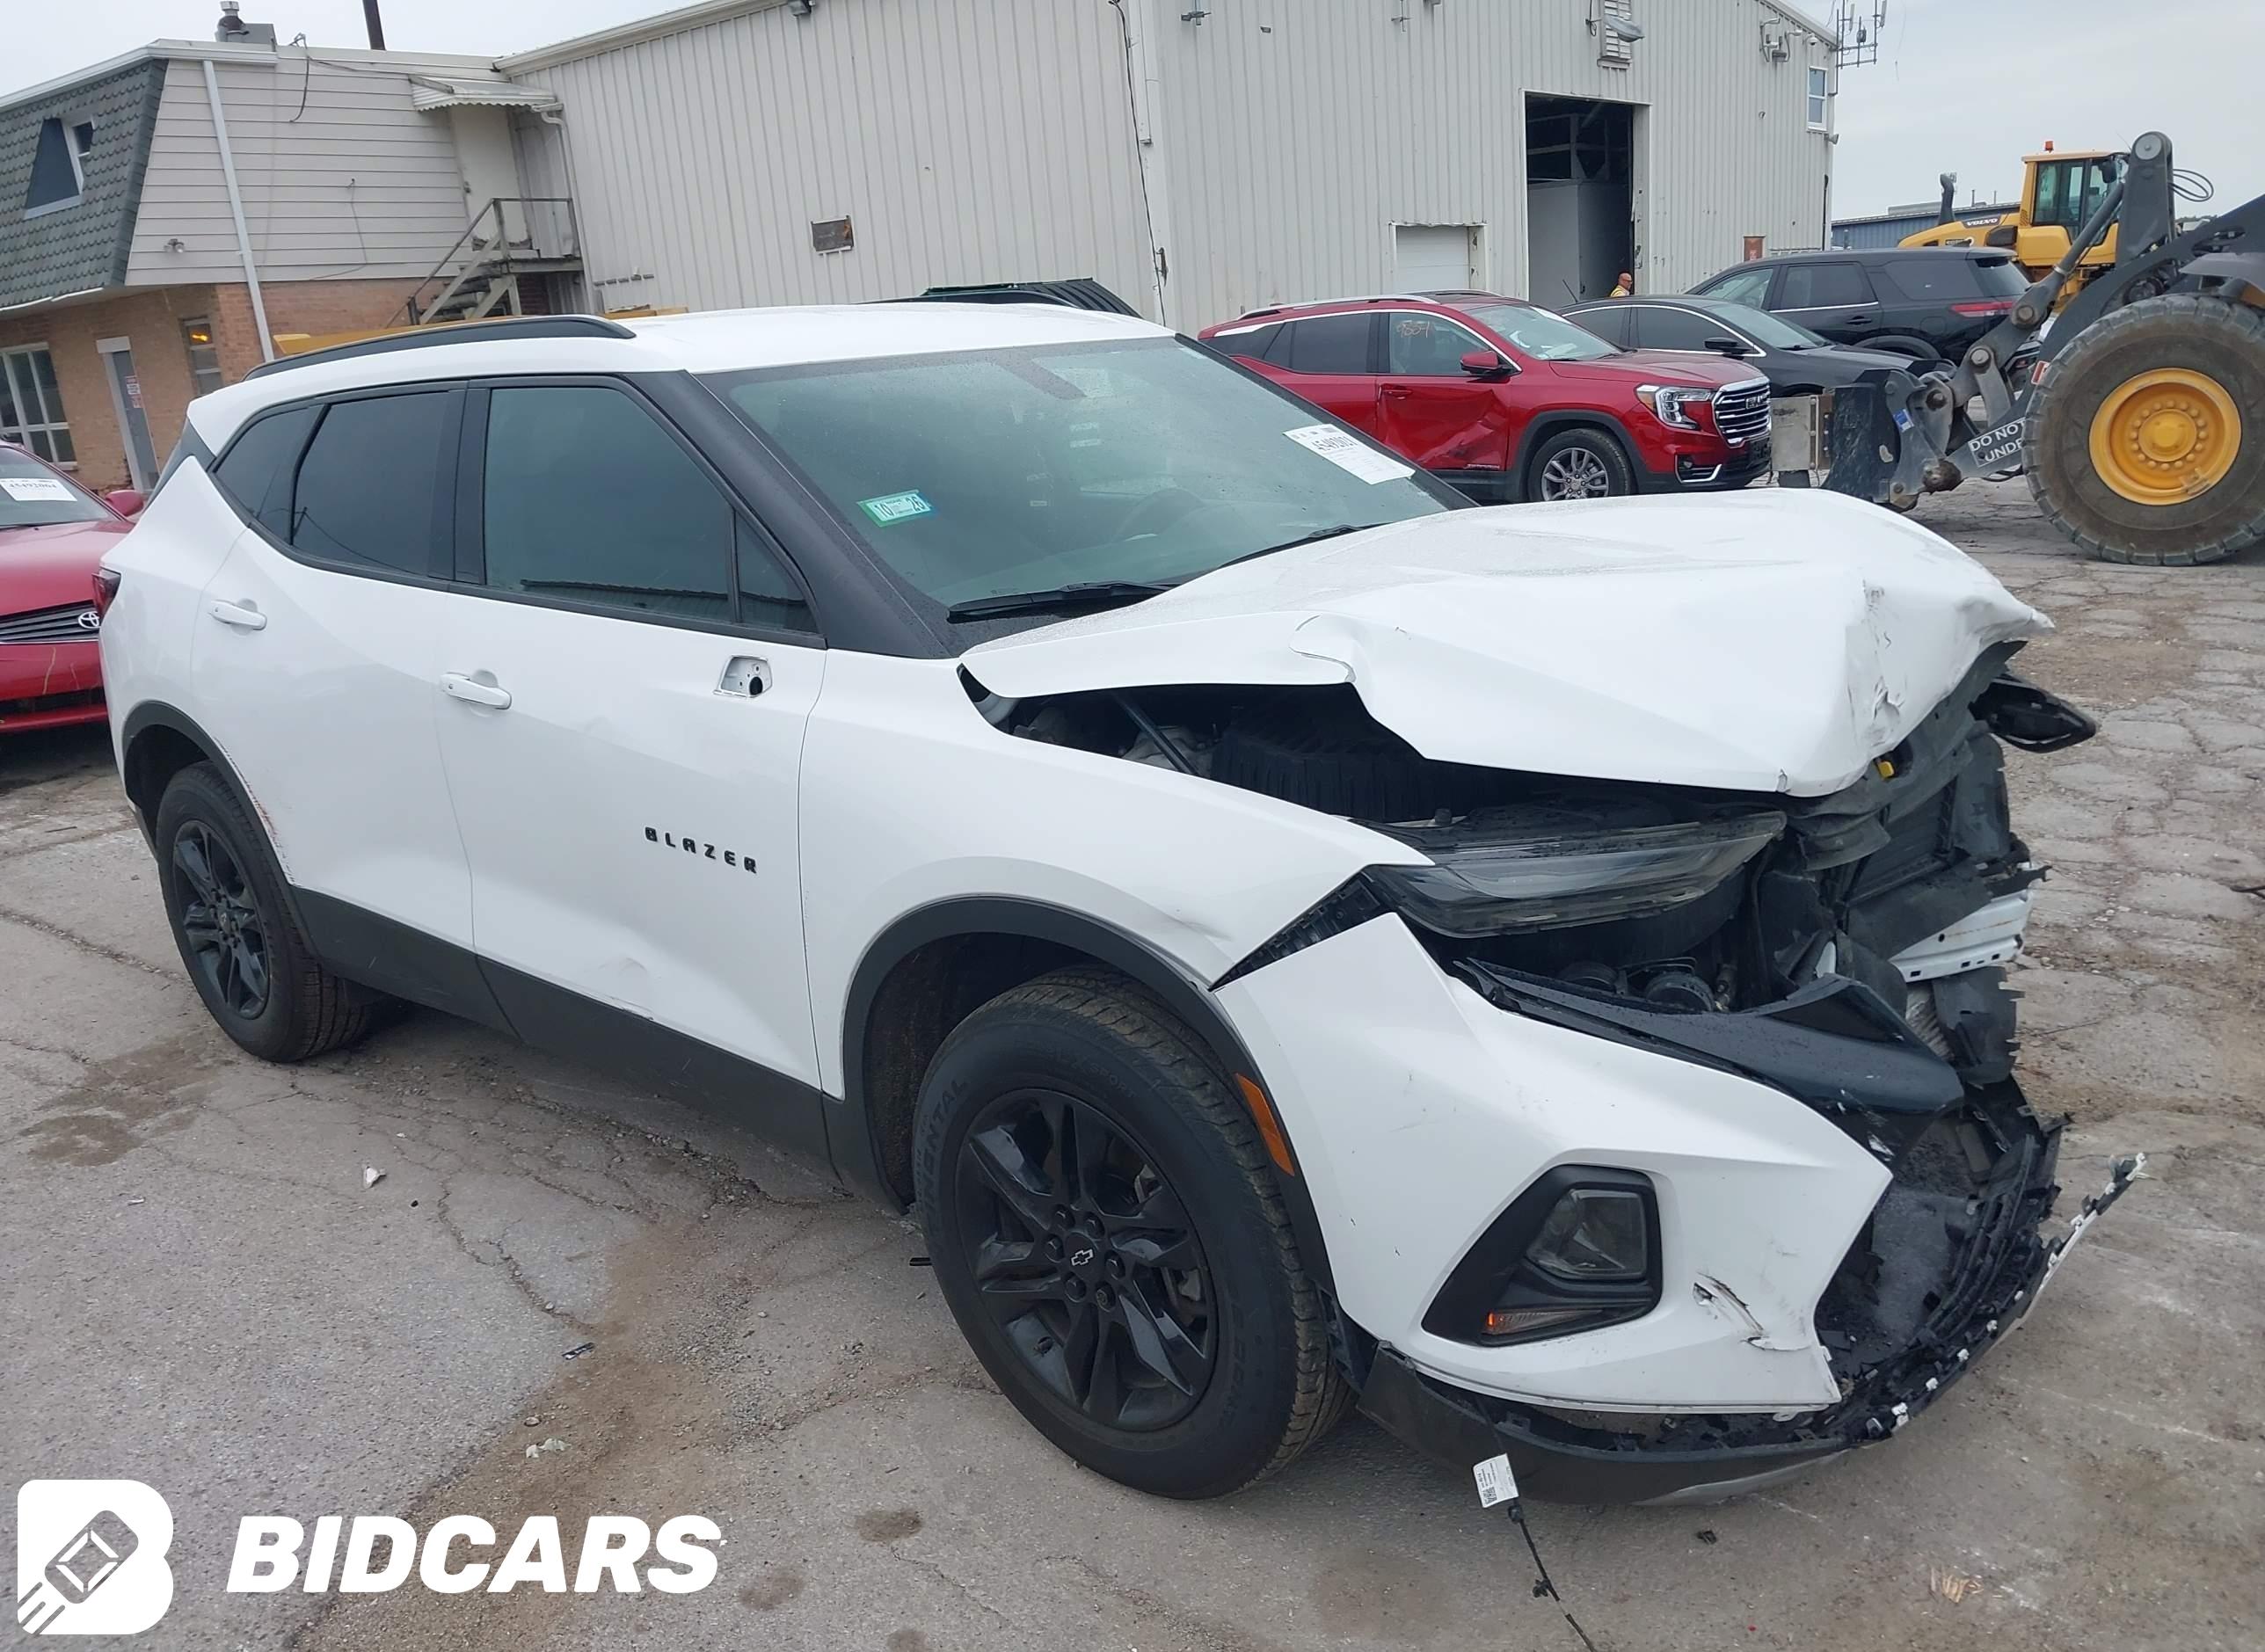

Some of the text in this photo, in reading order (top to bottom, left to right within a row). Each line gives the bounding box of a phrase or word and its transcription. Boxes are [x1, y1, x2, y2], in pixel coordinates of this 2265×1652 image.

[1965, 218, 1999, 227] VOLVO
[1970, 436, 1992, 452] DO
[874, 496, 926, 518] 10 26
[645, 826, 757, 874] BLAZER
